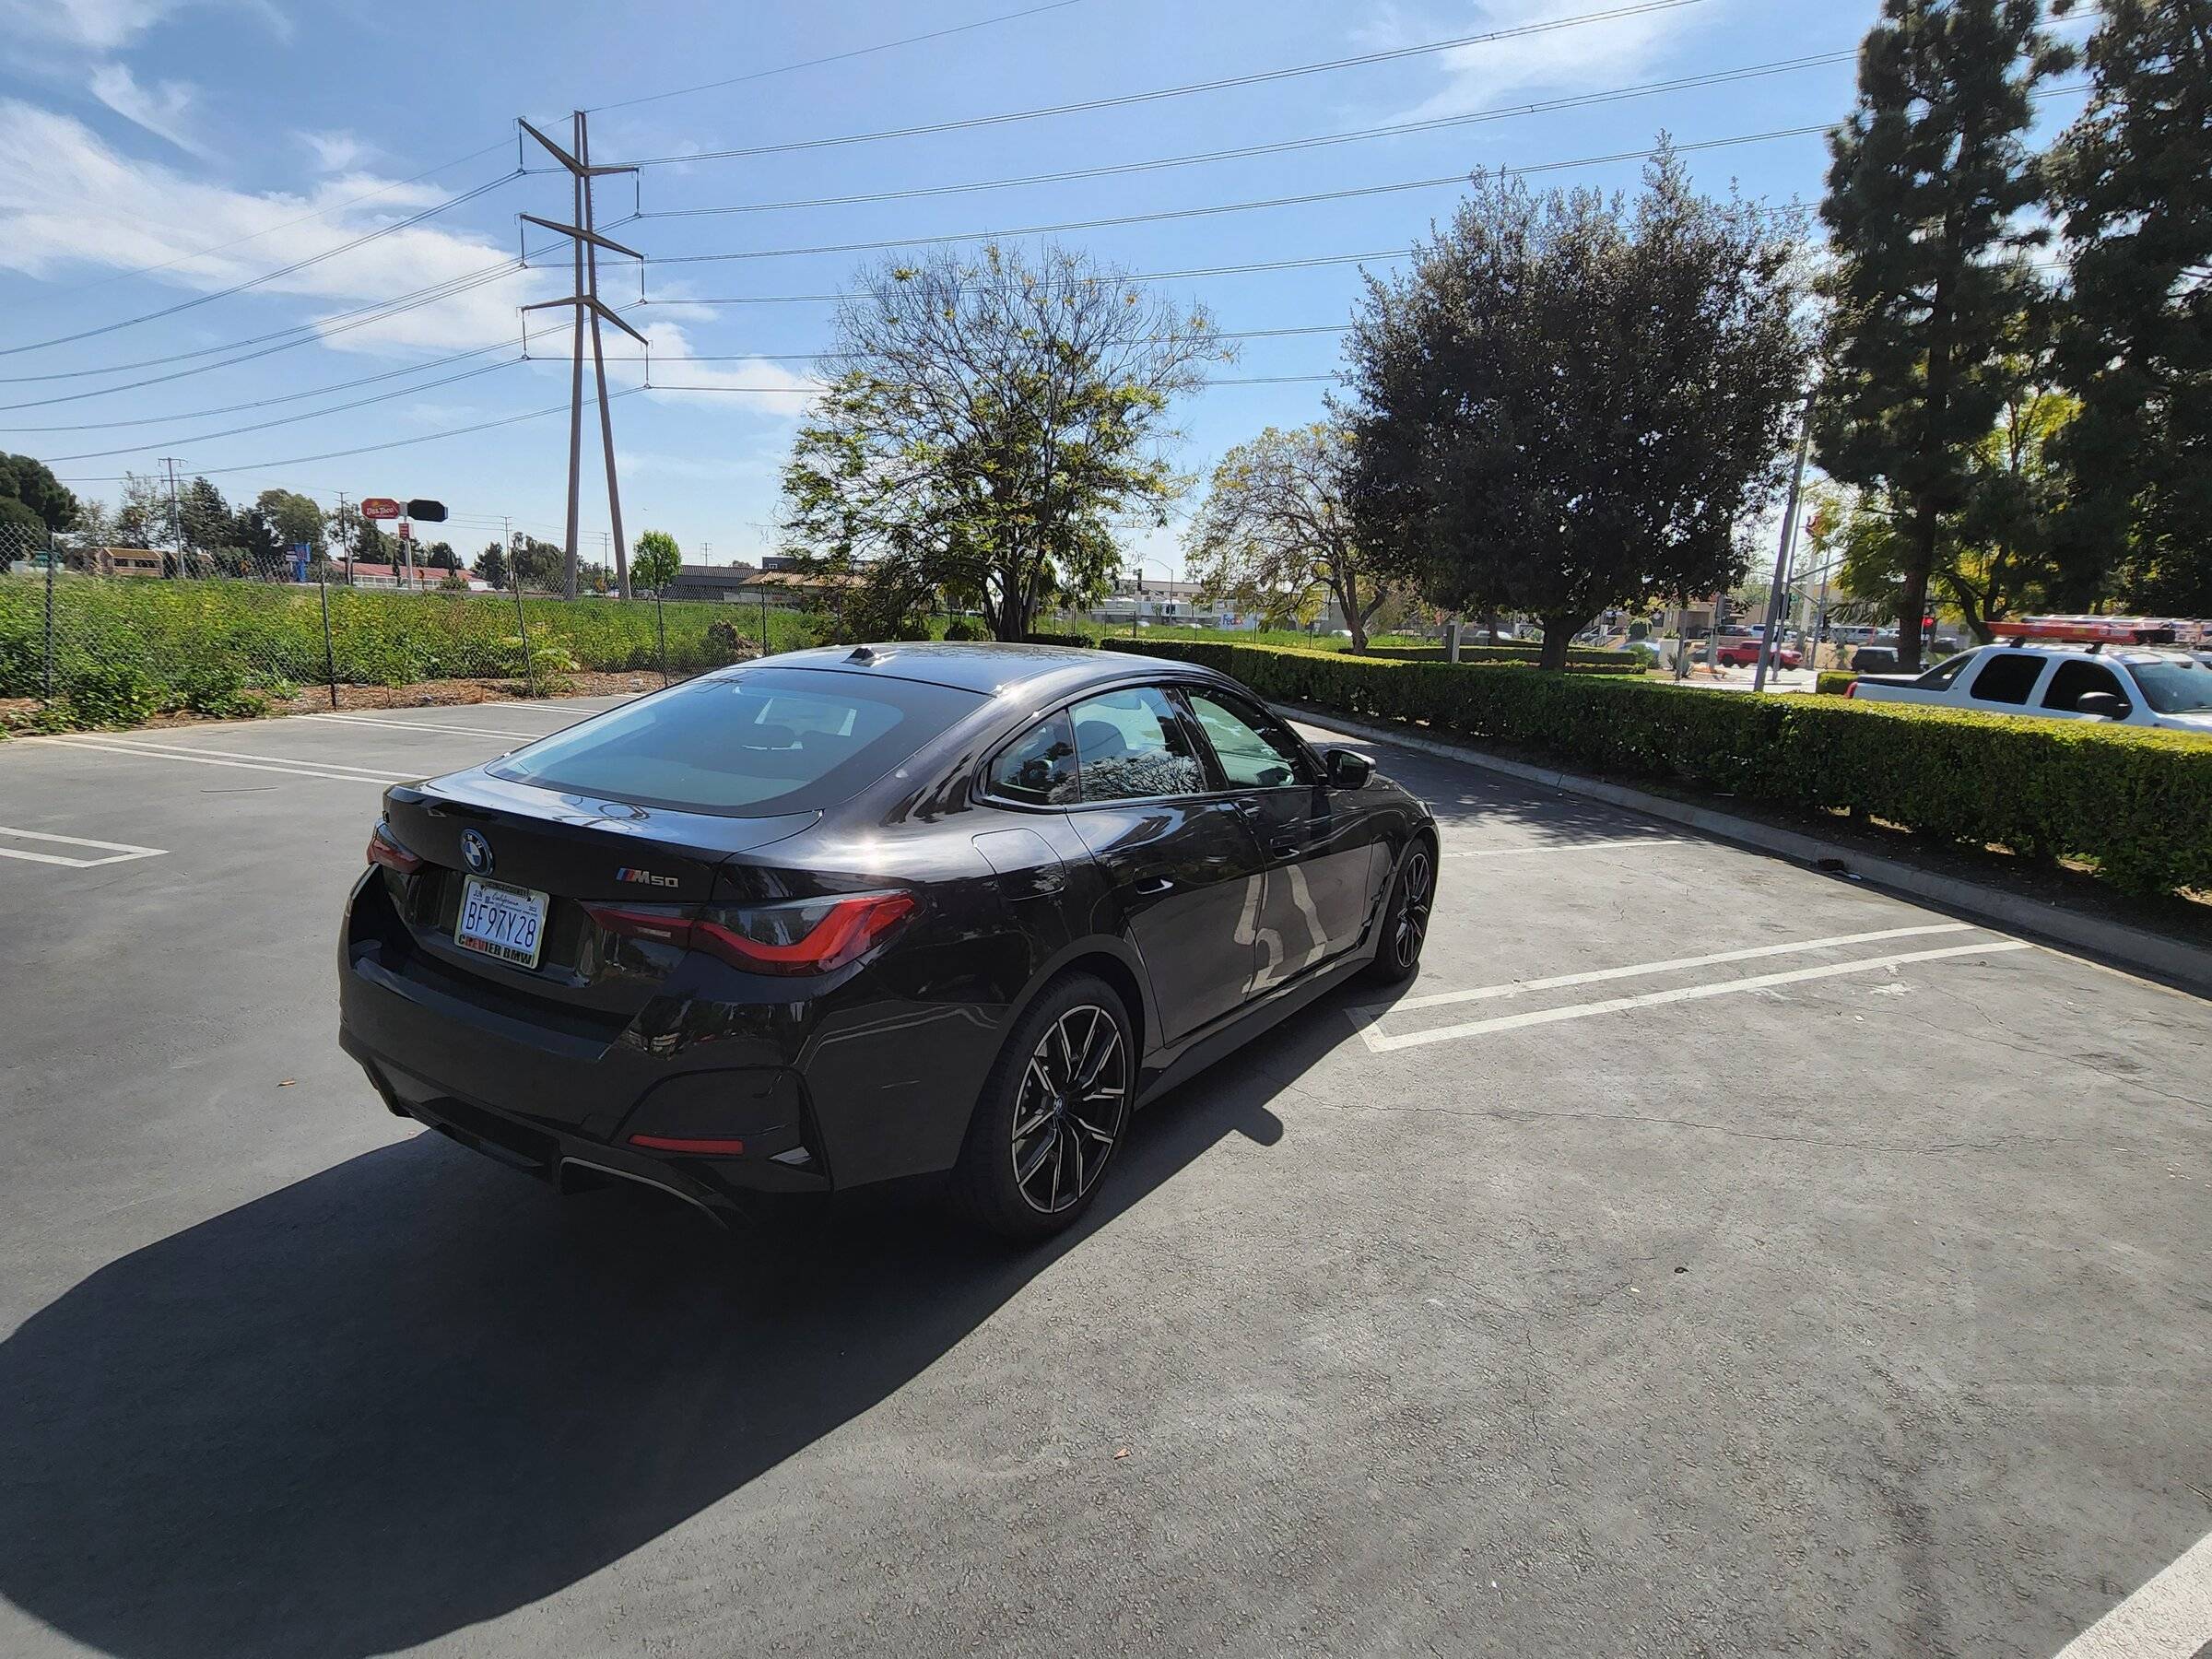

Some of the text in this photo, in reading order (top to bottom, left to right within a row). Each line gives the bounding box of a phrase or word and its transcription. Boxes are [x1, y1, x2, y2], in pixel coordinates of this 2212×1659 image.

[631, 869, 678, 888] M50
[465, 901, 536, 947] BF97Y28
[503, 947, 532, 965] BMW
